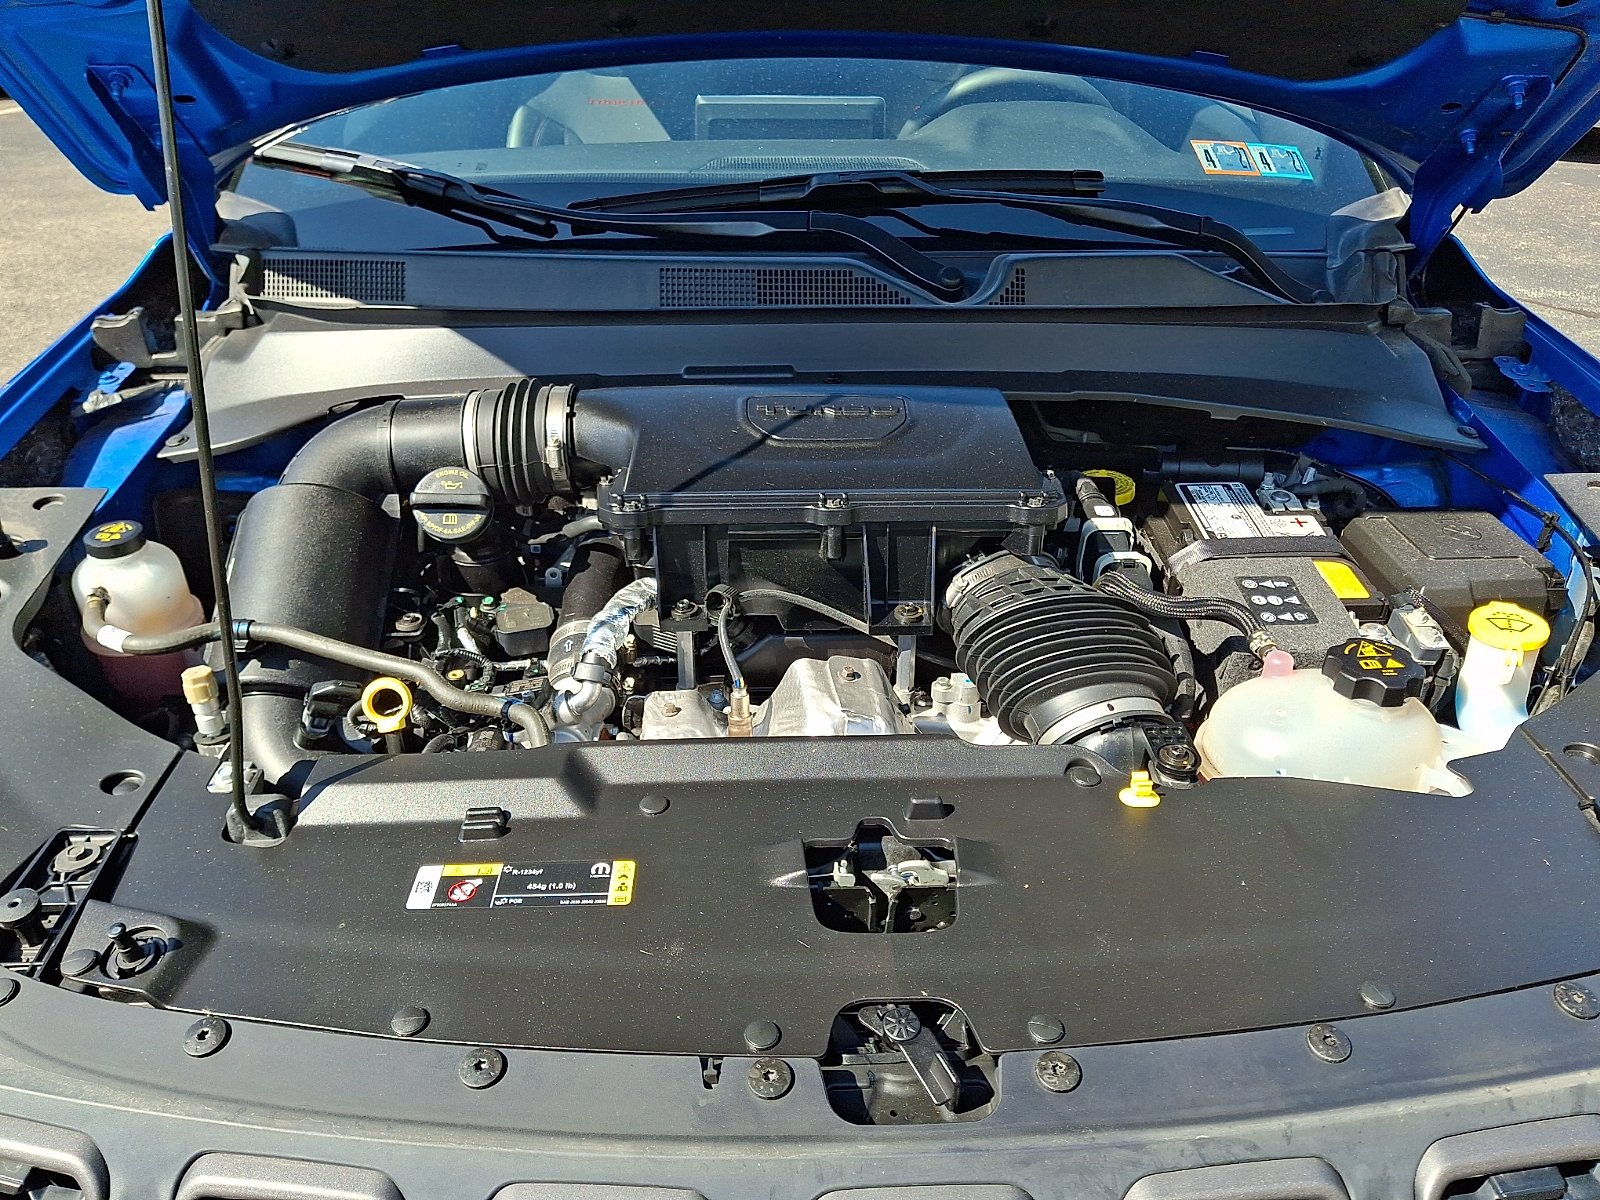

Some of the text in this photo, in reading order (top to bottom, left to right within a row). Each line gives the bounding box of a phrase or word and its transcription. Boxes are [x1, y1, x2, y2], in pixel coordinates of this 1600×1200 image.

[1203, 149, 1217, 168] 4
[1258, 151, 1272, 171] 4
[435, 469, 469, 479] ENGINE OIL
[526, 883, 547, 891] 454g
